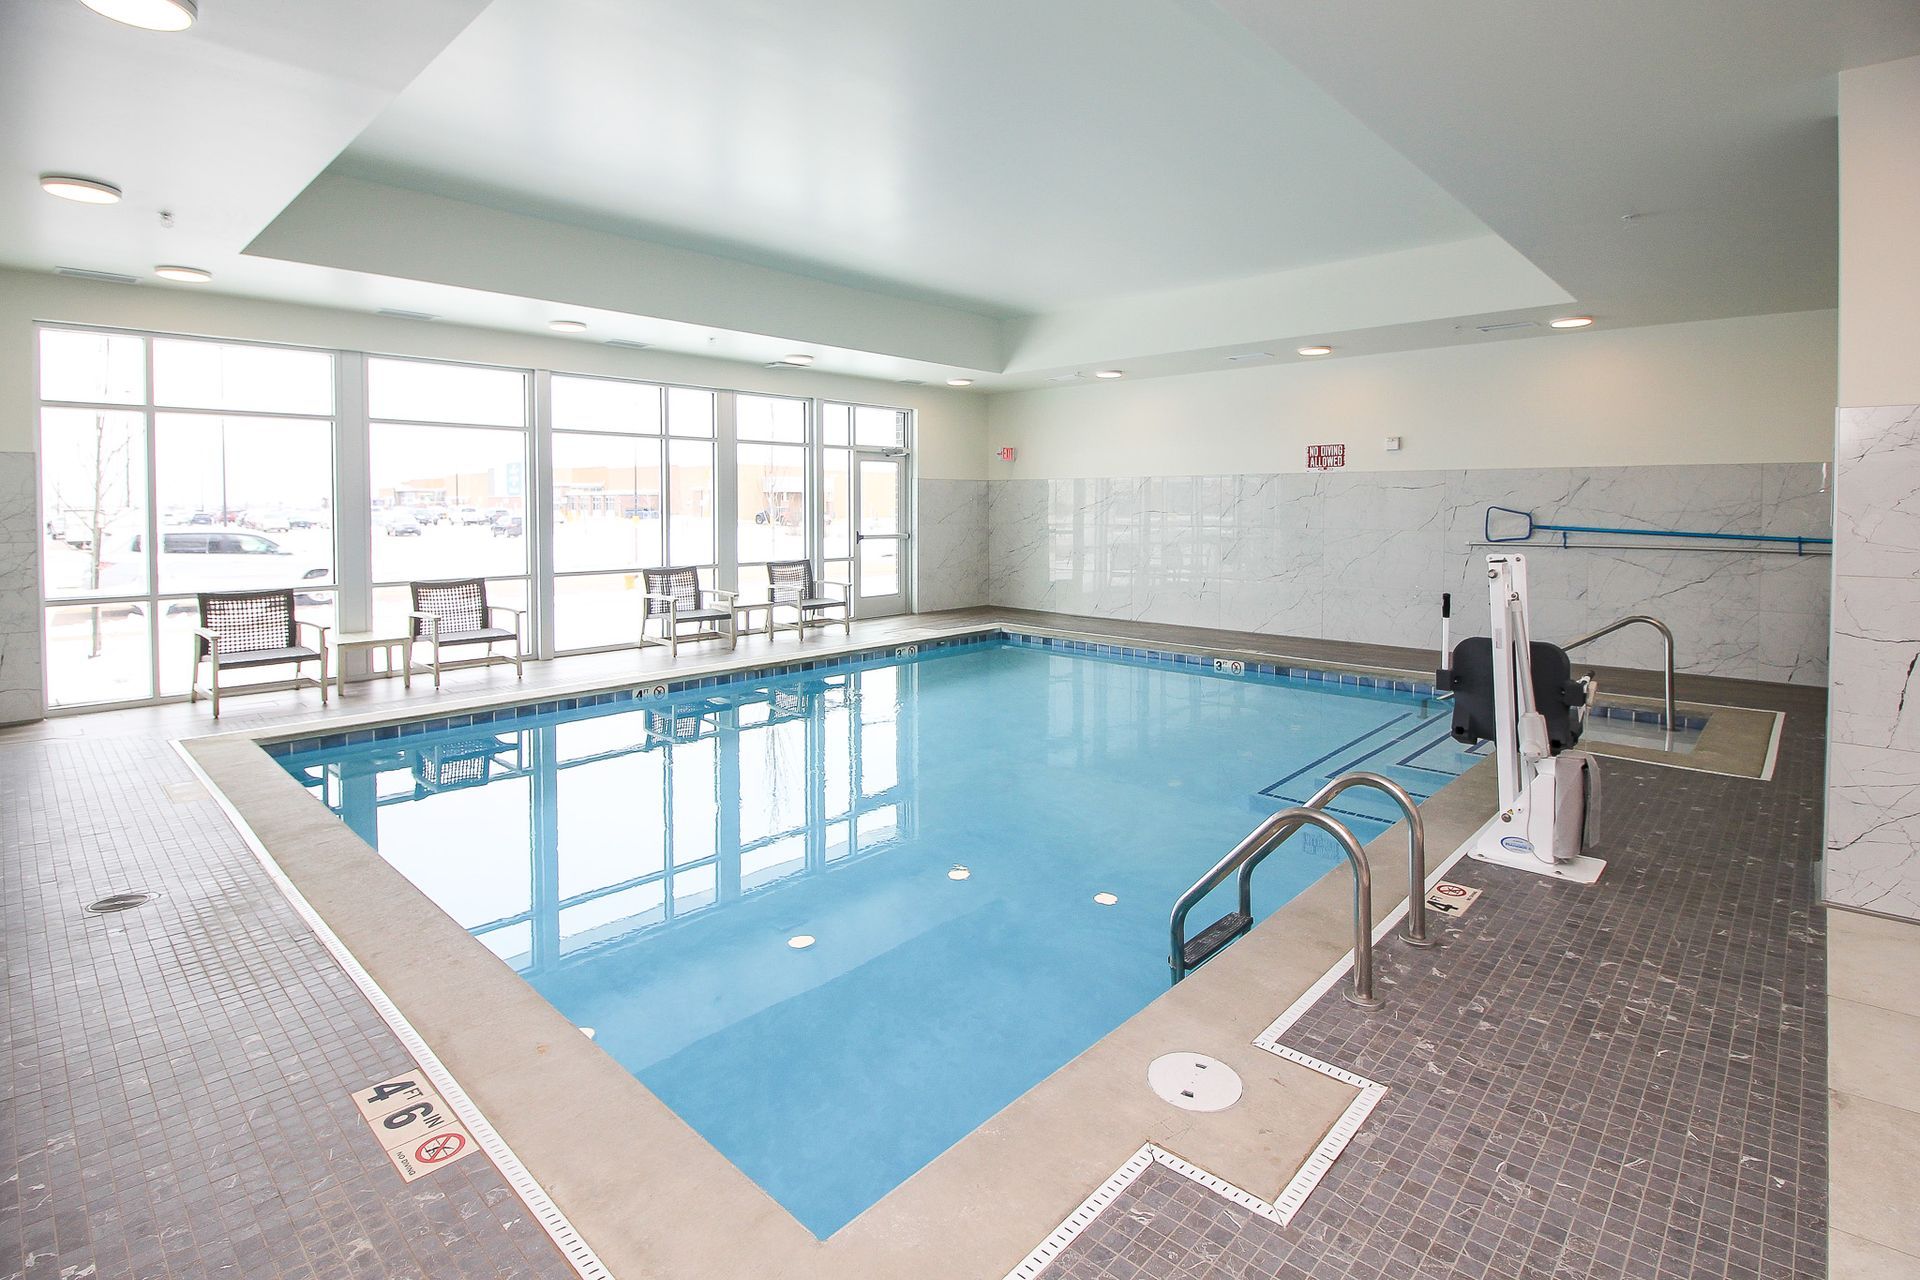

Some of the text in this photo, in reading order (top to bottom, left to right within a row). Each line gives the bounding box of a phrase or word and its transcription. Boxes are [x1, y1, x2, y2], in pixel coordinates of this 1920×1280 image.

[1310, 445, 1343, 457] NO DIVING
[1310, 456, 1343, 468] ALLOWED
[1215, 660, 1222, 671] 3
[1426, 900, 1459, 912] 4
[367, 1080, 424, 1104] 4 FT
[383, 1101, 445, 1130] 6 IN
[396, 1150, 416, 1176] NO DIVING
